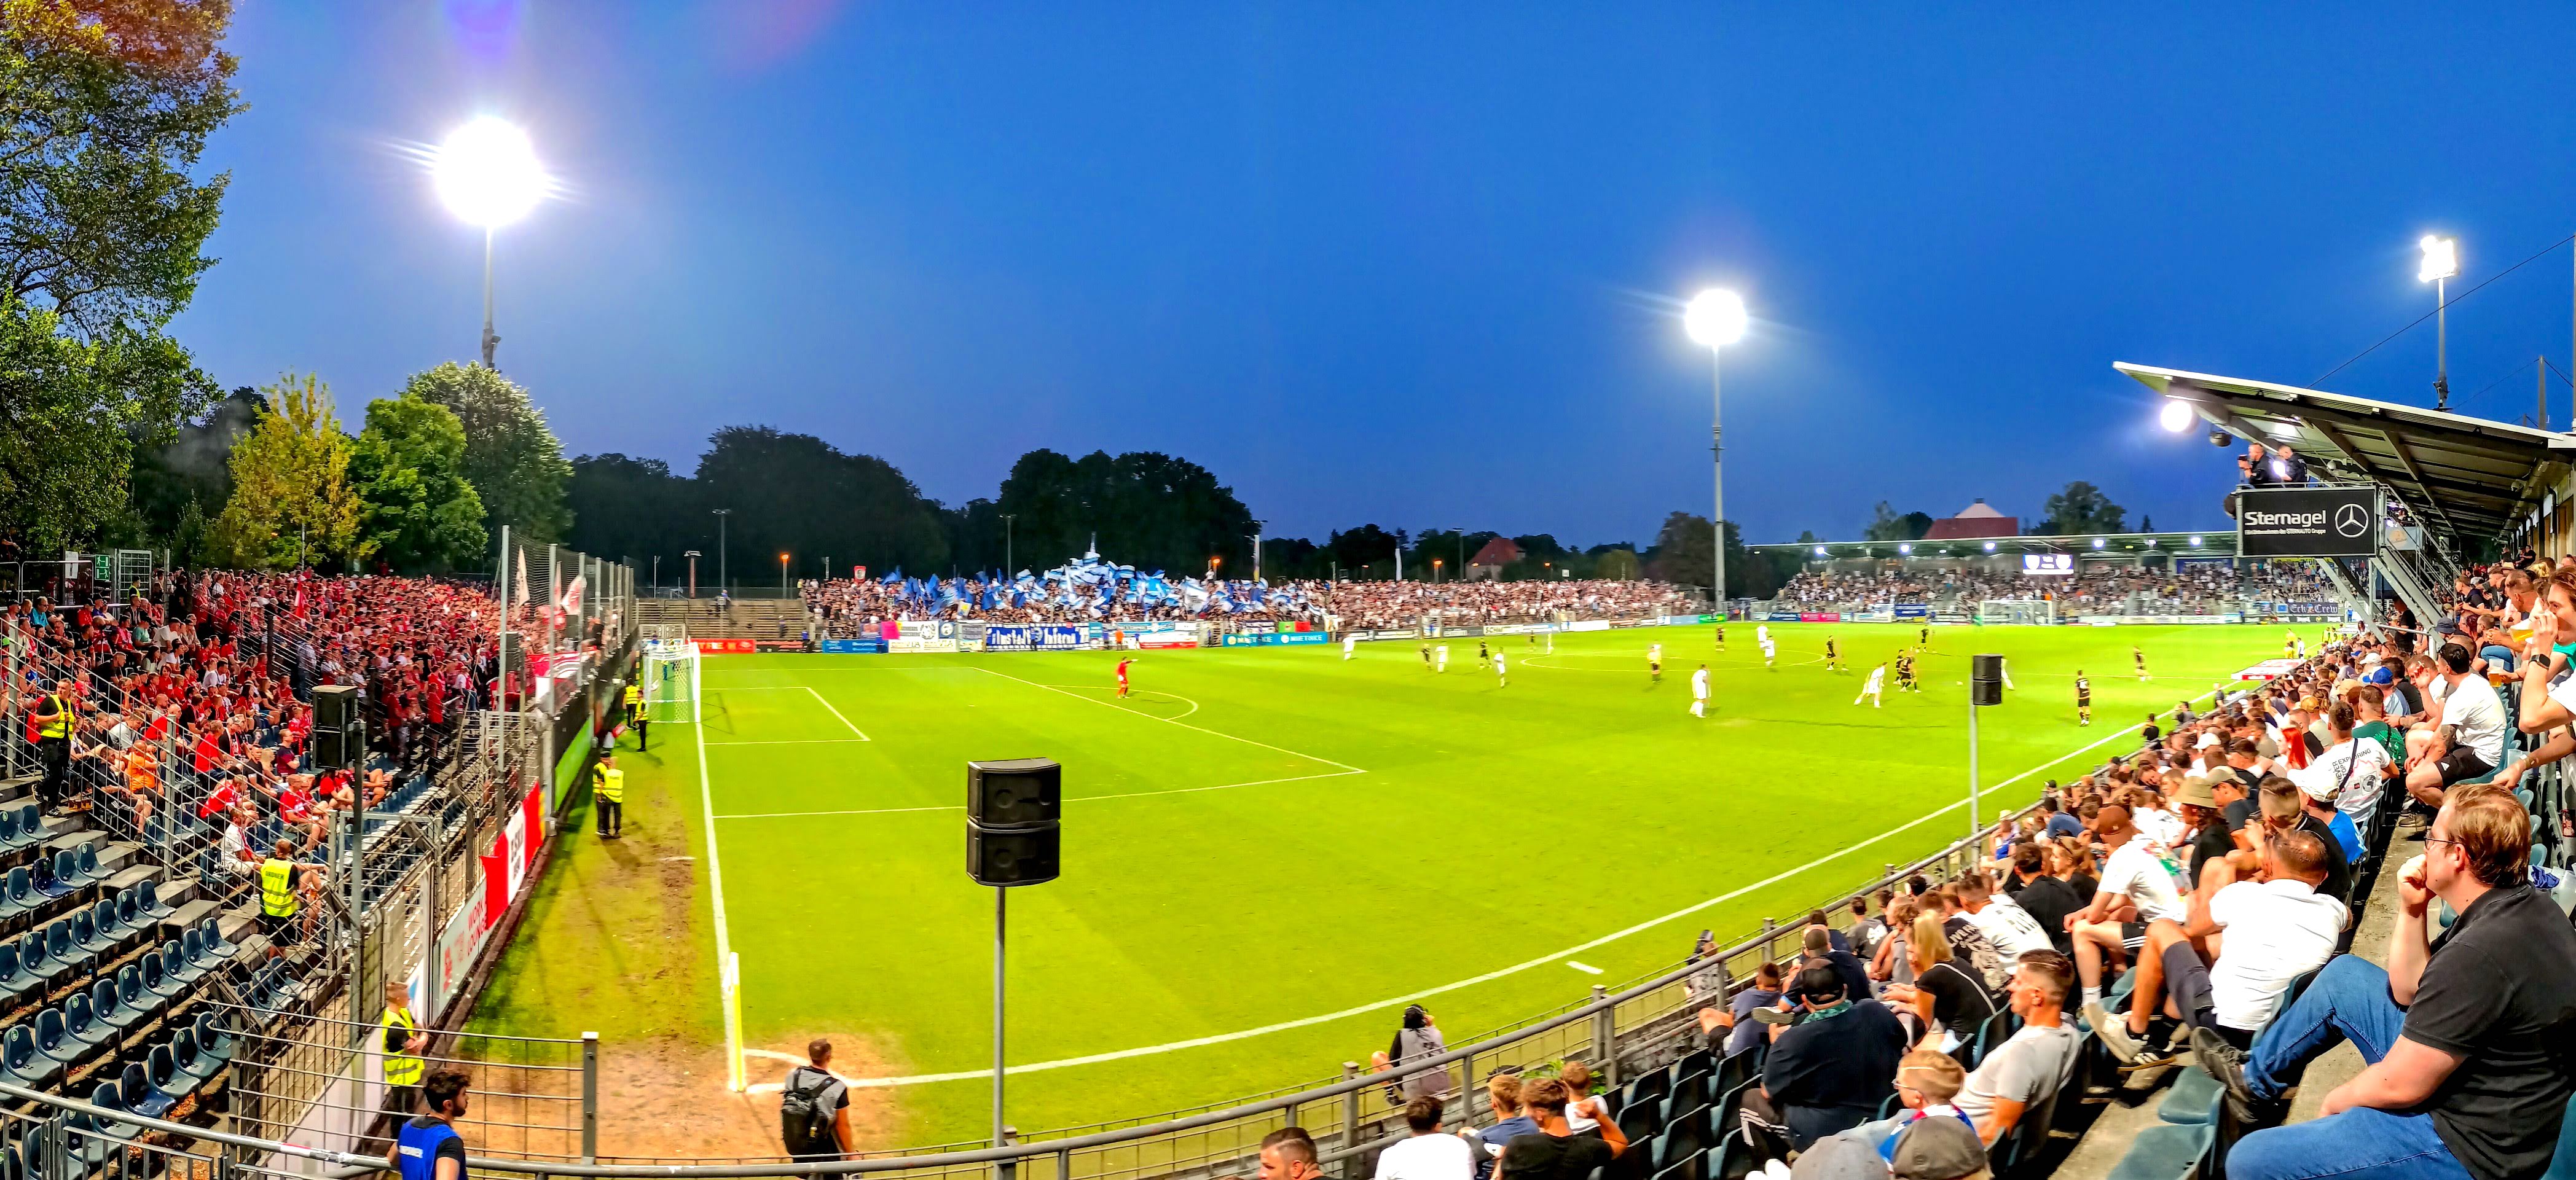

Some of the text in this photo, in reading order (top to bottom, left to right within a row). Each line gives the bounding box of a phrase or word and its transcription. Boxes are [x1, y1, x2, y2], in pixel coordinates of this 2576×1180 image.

[2244, 510, 2327, 527] Sternagel
[2290, 604, 2338, 613] Eck Crew
